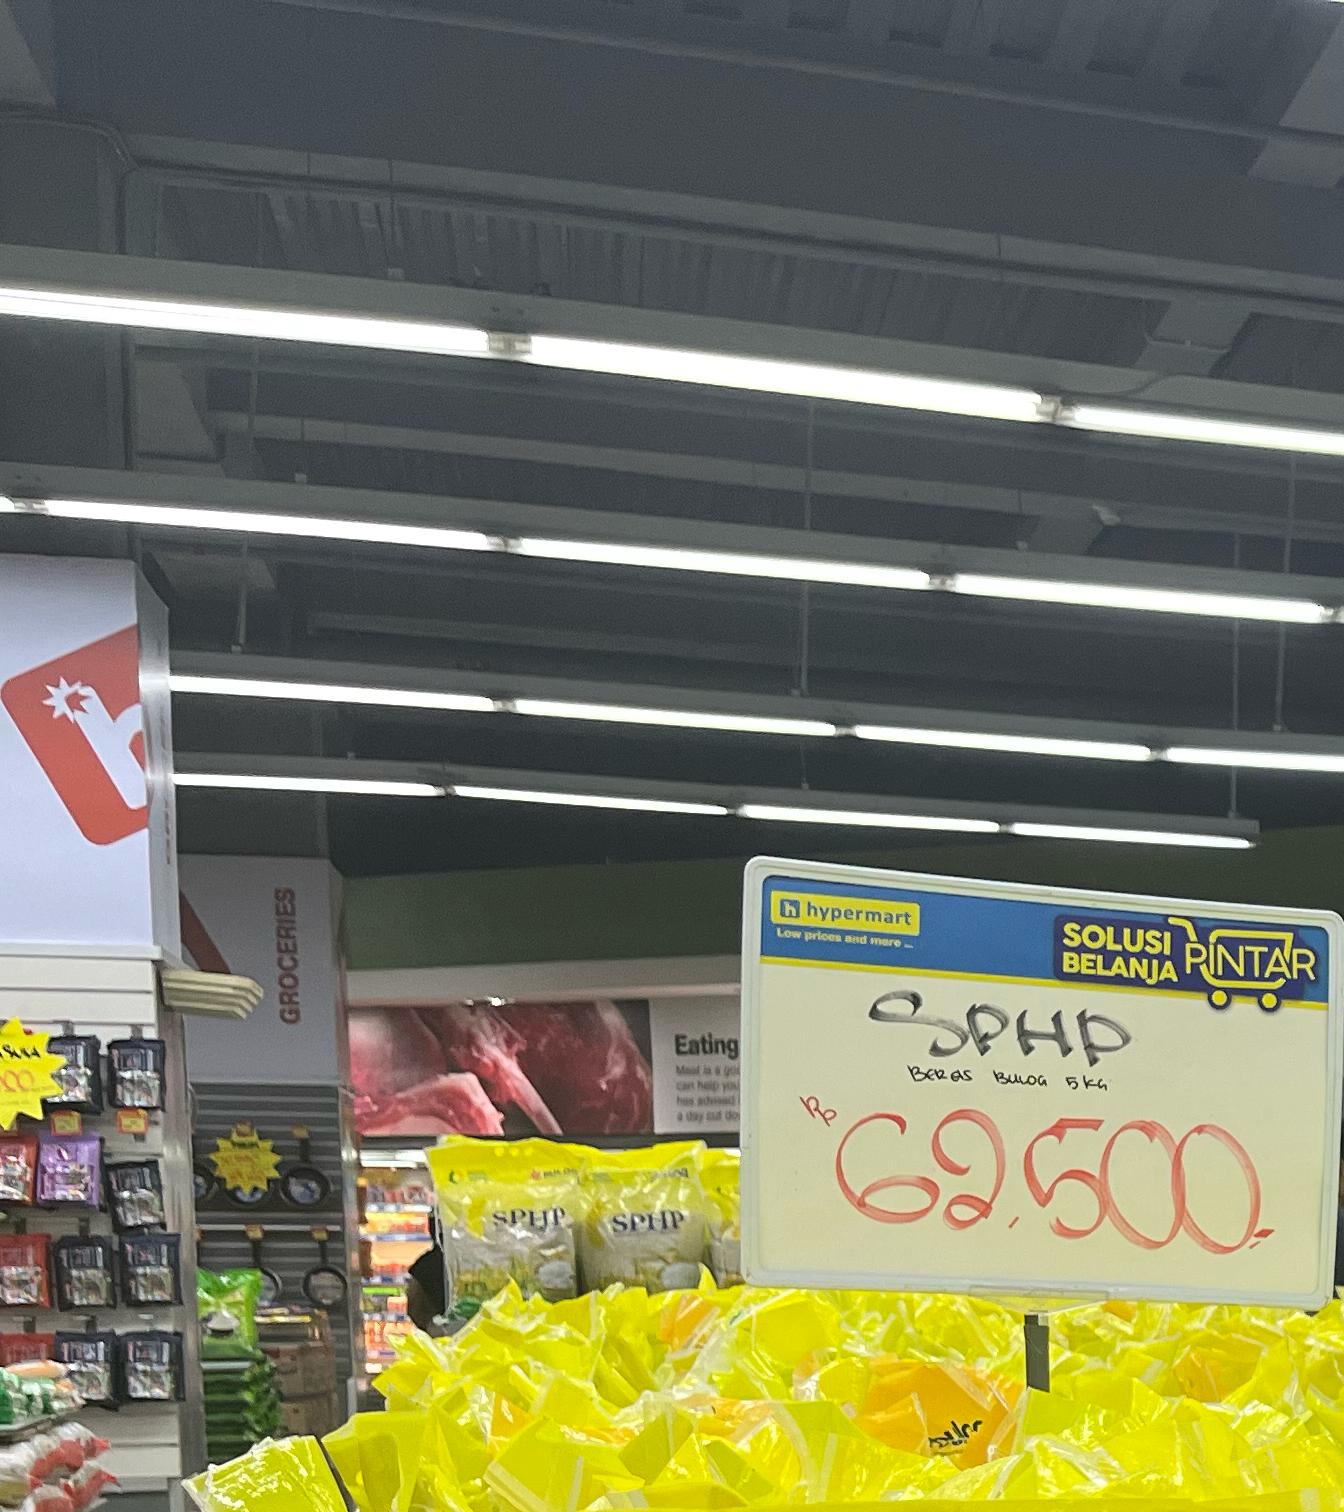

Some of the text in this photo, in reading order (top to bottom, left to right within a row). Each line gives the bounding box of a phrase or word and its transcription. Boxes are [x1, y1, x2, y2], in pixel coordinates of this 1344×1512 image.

[806, 902, 913, 926] hypermart
[1063, 922, 1171, 955] SOLUSI
[274, 887, 298, 1025] GROCERIES
[1063, 952, 1179, 985] BELANJA
[1184, 942, 1317, 982] PINTAR
[869, 990, 1132, 1067] SPHP
[675, 1032, 739, 1060] Eating
[1065, 1077, 1078, 1089] 5
[492, 1207, 566, 1231] SPHP
[612, 1210, 685, 1233] SPHP
